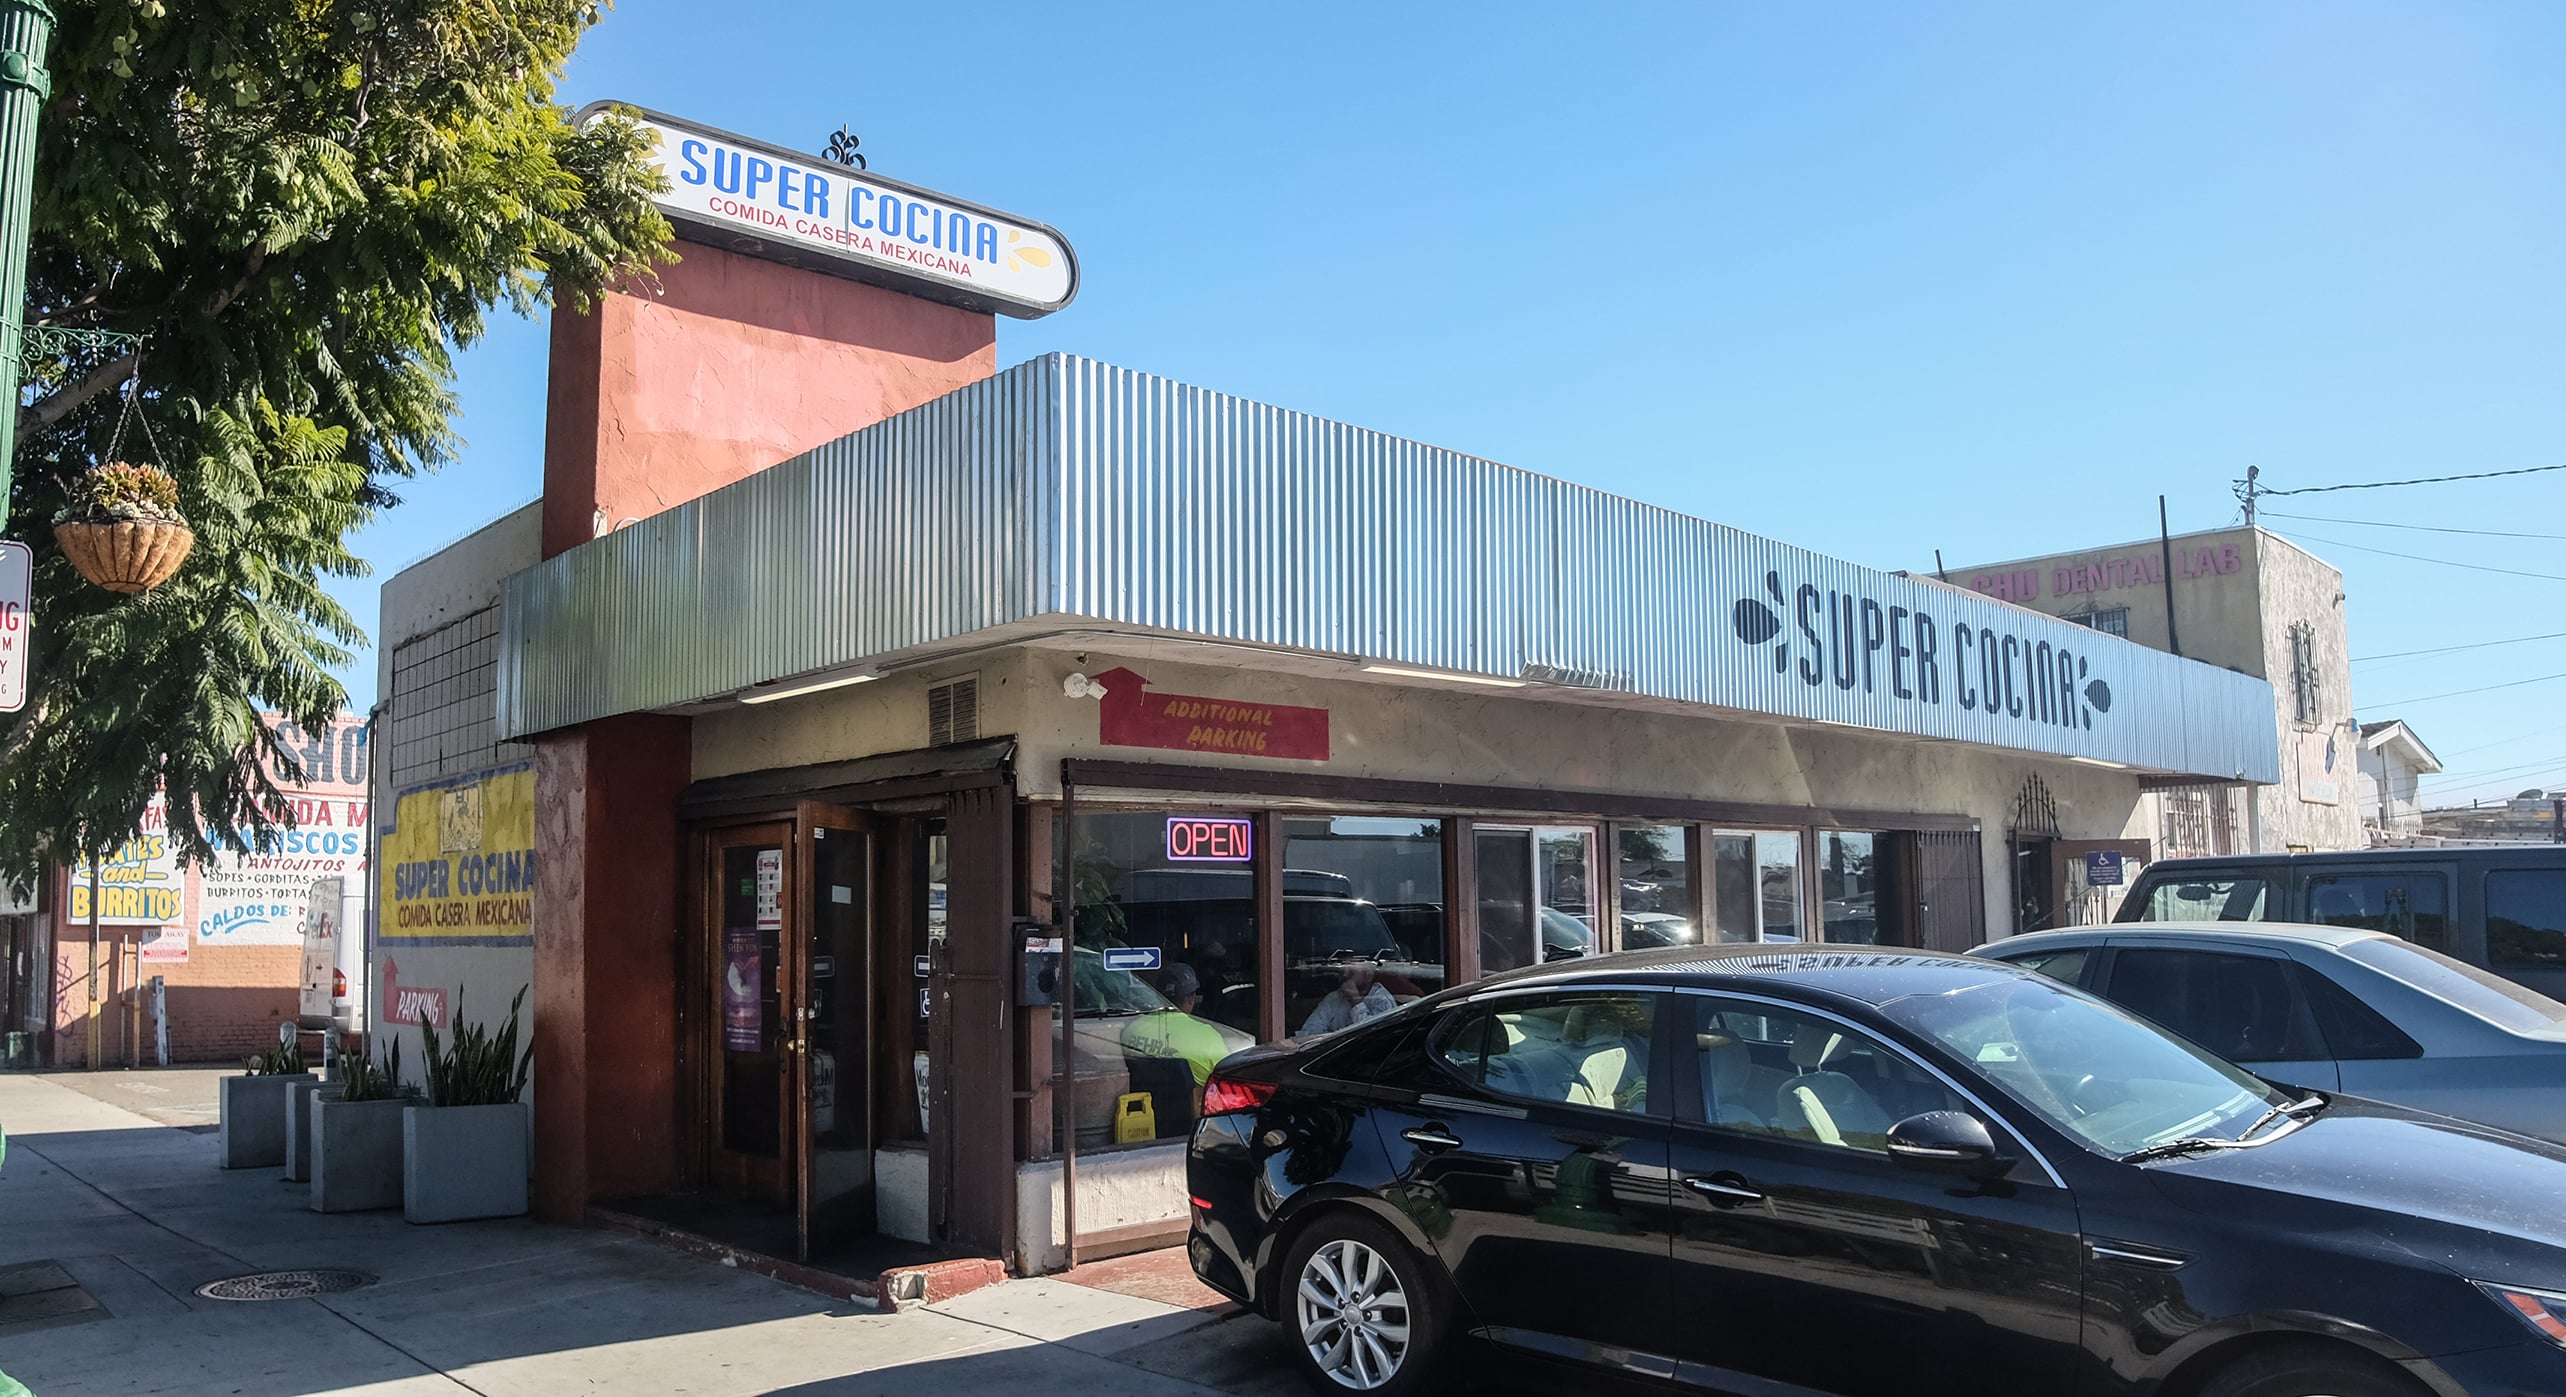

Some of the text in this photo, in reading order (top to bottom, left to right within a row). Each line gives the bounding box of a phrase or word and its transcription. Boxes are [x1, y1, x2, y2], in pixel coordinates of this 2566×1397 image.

[681, 140, 997, 264] SUPER COCINA
[709, 197, 972, 277] COMIDA CASERA MEXICANA
[2053, 556, 2163, 597] DENTAL
[2176, 544, 2240, 579] LAB
[1797, 583, 2077, 729] SUPER COCINA
[1164, 700, 1272, 726] ADDITIONAL
[1186, 725, 1267, 751] PARKING
[1172, 823, 1247, 856] OPEN
[103, 860, 147, 884] and
[209, 872, 244, 883] SOPES
[254, 874, 310, 884] GORDITAS
[249, 857, 345, 872] ANTOJITOS
[395, 849, 535, 901] SUPER COCINA
[207, 888, 263, 899] BURRITOS
[200, 905, 264, 937] CALDOS
[399, 899, 532, 928] COMIDA CASERA MEXICANA
[396, 991, 439, 1025] PARKING
